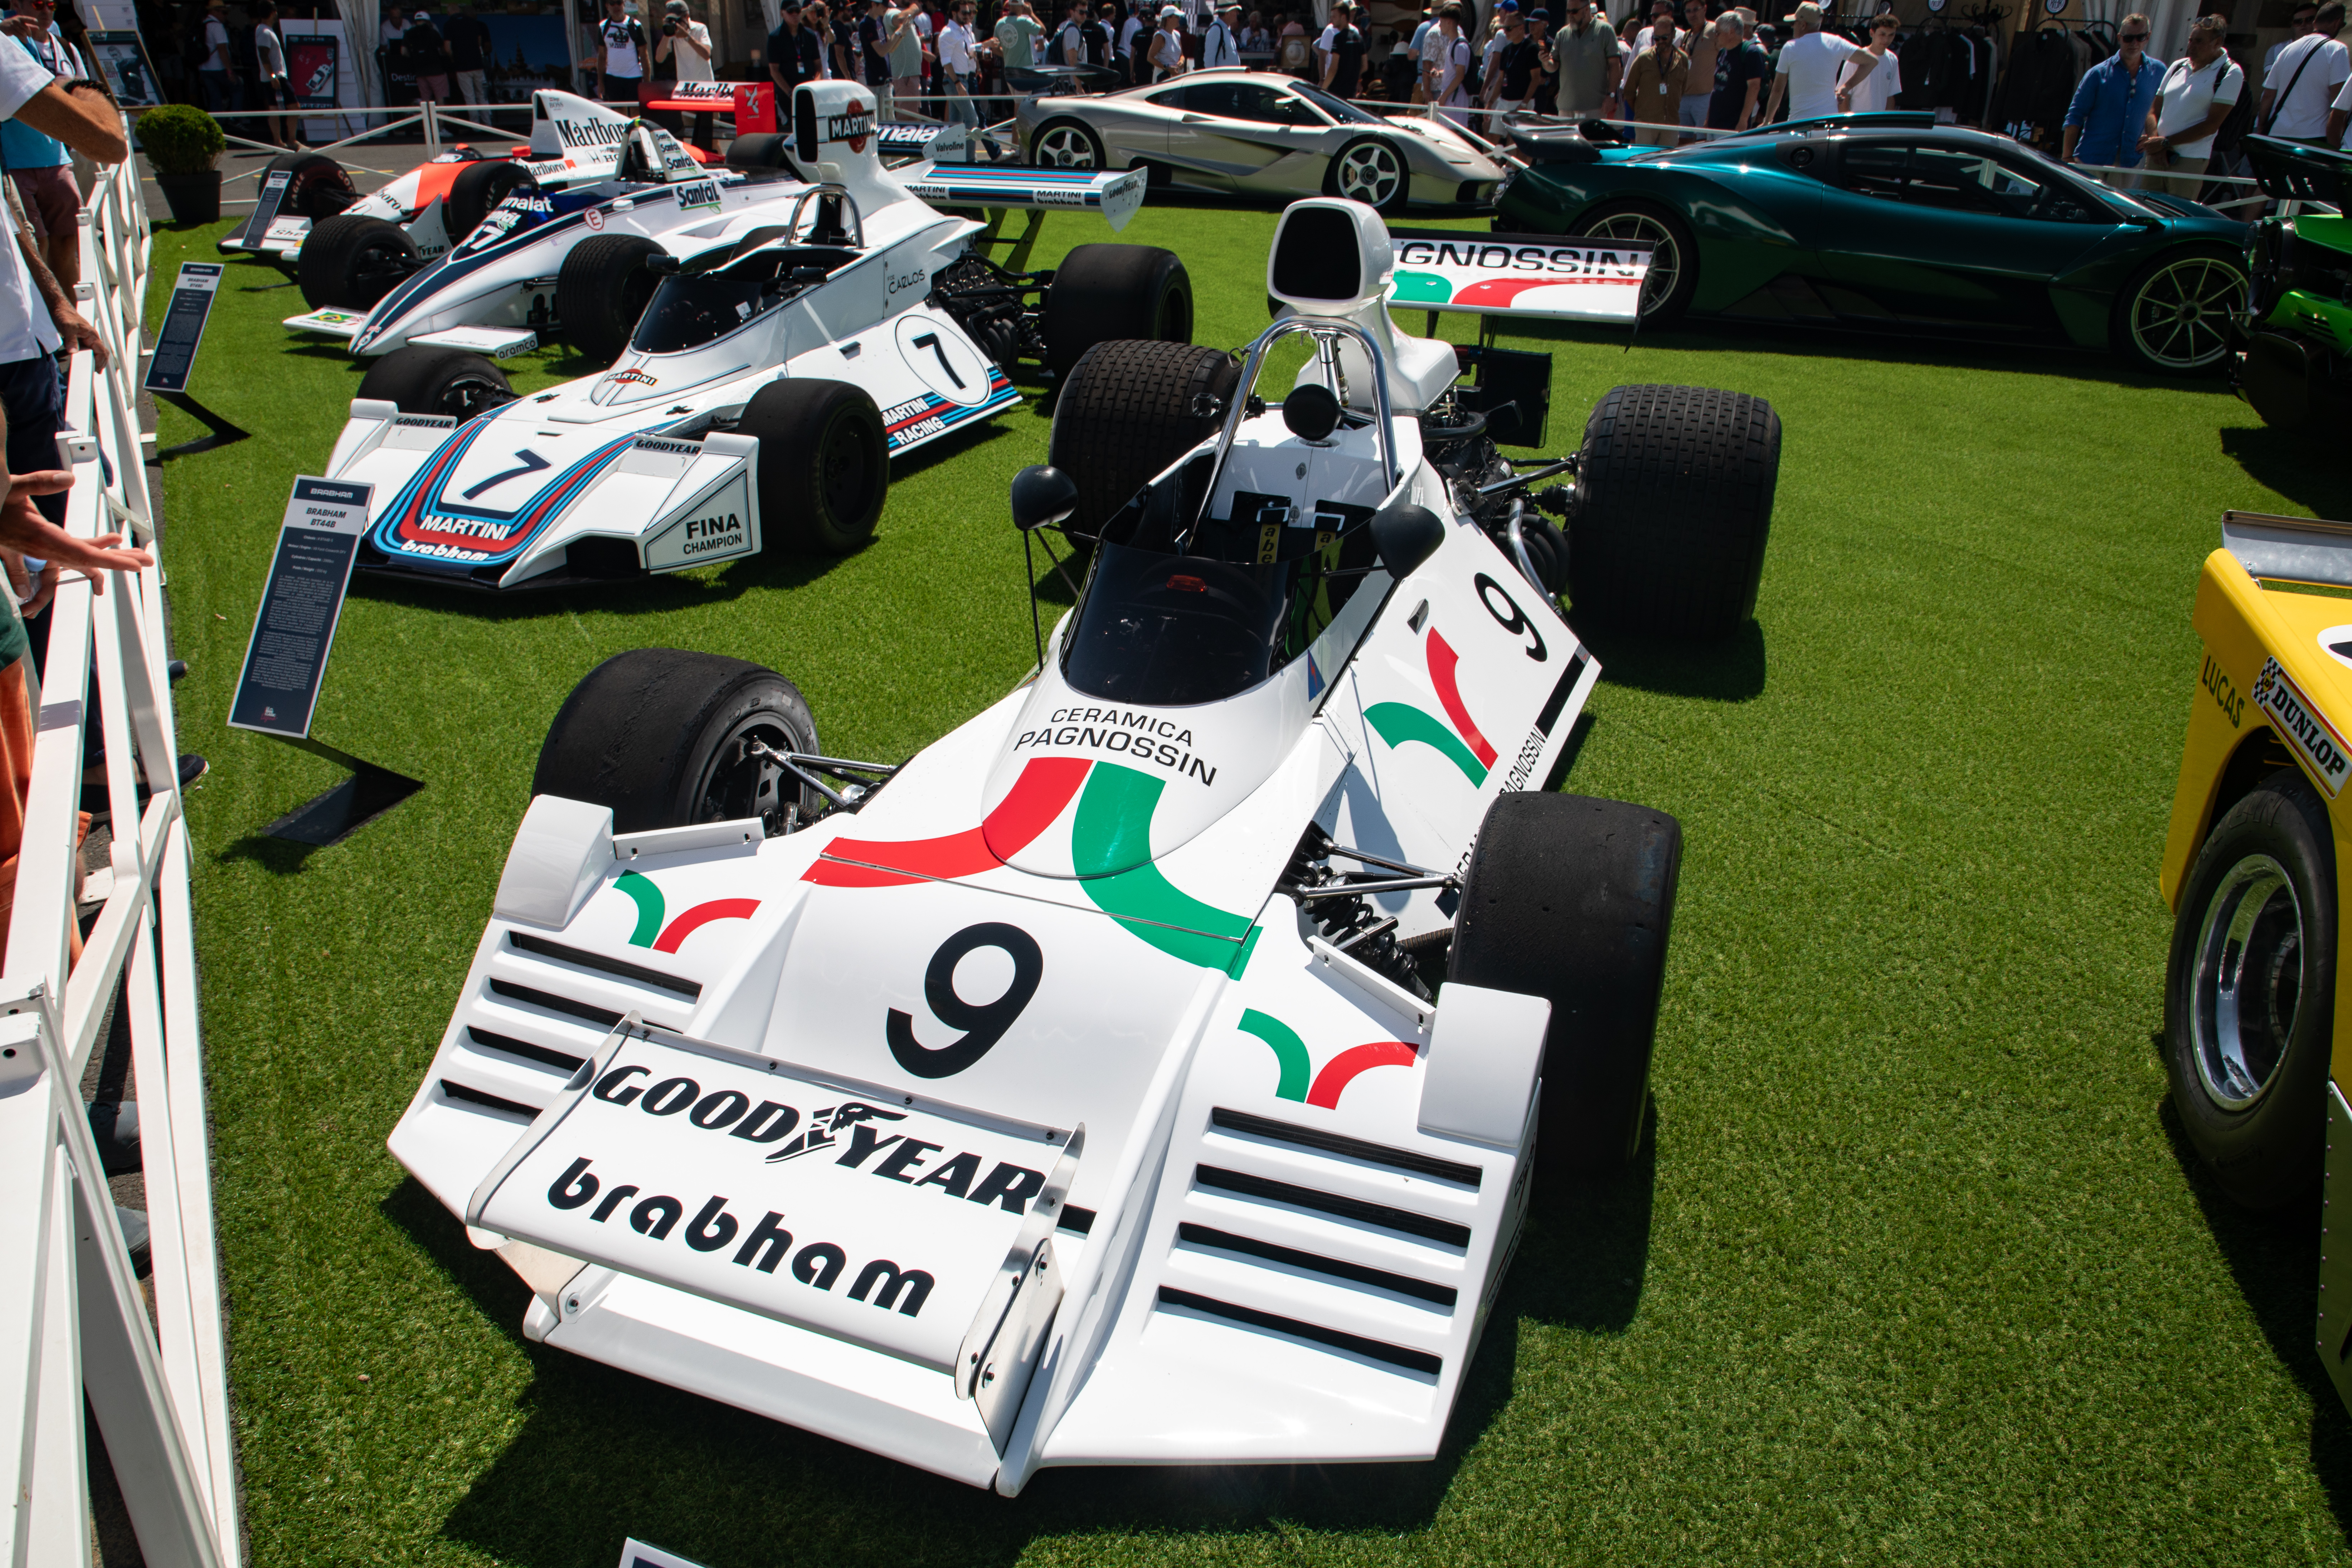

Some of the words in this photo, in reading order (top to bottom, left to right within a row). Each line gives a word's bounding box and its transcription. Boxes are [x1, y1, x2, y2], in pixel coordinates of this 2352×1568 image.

[831, 113, 877, 138] MARTINI
[935, 142, 964, 153] Valvoline
[291, 172, 305, 209] EAGLE
[1037, 190, 1081, 199] MARTINI
[1109, 180, 1138, 199] GOODYEAR
[889, 269, 925, 294] CARLOS
[911, 332, 967, 390] 7
[605, 370, 656, 386] MARTINI
[395, 417, 453, 429] GOODYEAR
[882, 397, 930, 427] MARTINI
[893, 416, 947, 445] RACING
[636, 439, 701, 455] GOODYEAR
[462, 449, 552, 501] 7
[310, 488, 353, 499] BRABHAM
[306, 507, 347, 518] BRABHAM
[310, 518, 336, 528] BT44B
[420, 514, 511, 541] MARTINI
[686, 513, 741, 540] FINA
[400, 539, 490, 562] brabham
[683, 533, 743, 555] CHAMPION
[1474, 572, 1547, 662] 9
[2201, 655, 2245, 729] LUCAS
[1051, 708, 1192, 747] CERAMICA
[2271, 684, 2346, 776] DUNLOP
[1013, 727, 1217, 787] PAGNOSSIN
[886, 922, 1043, 1079] 9
[593, 1064, 1047, 1216] GOODYEAR
[548, 1157, 935, 1318] brabham
